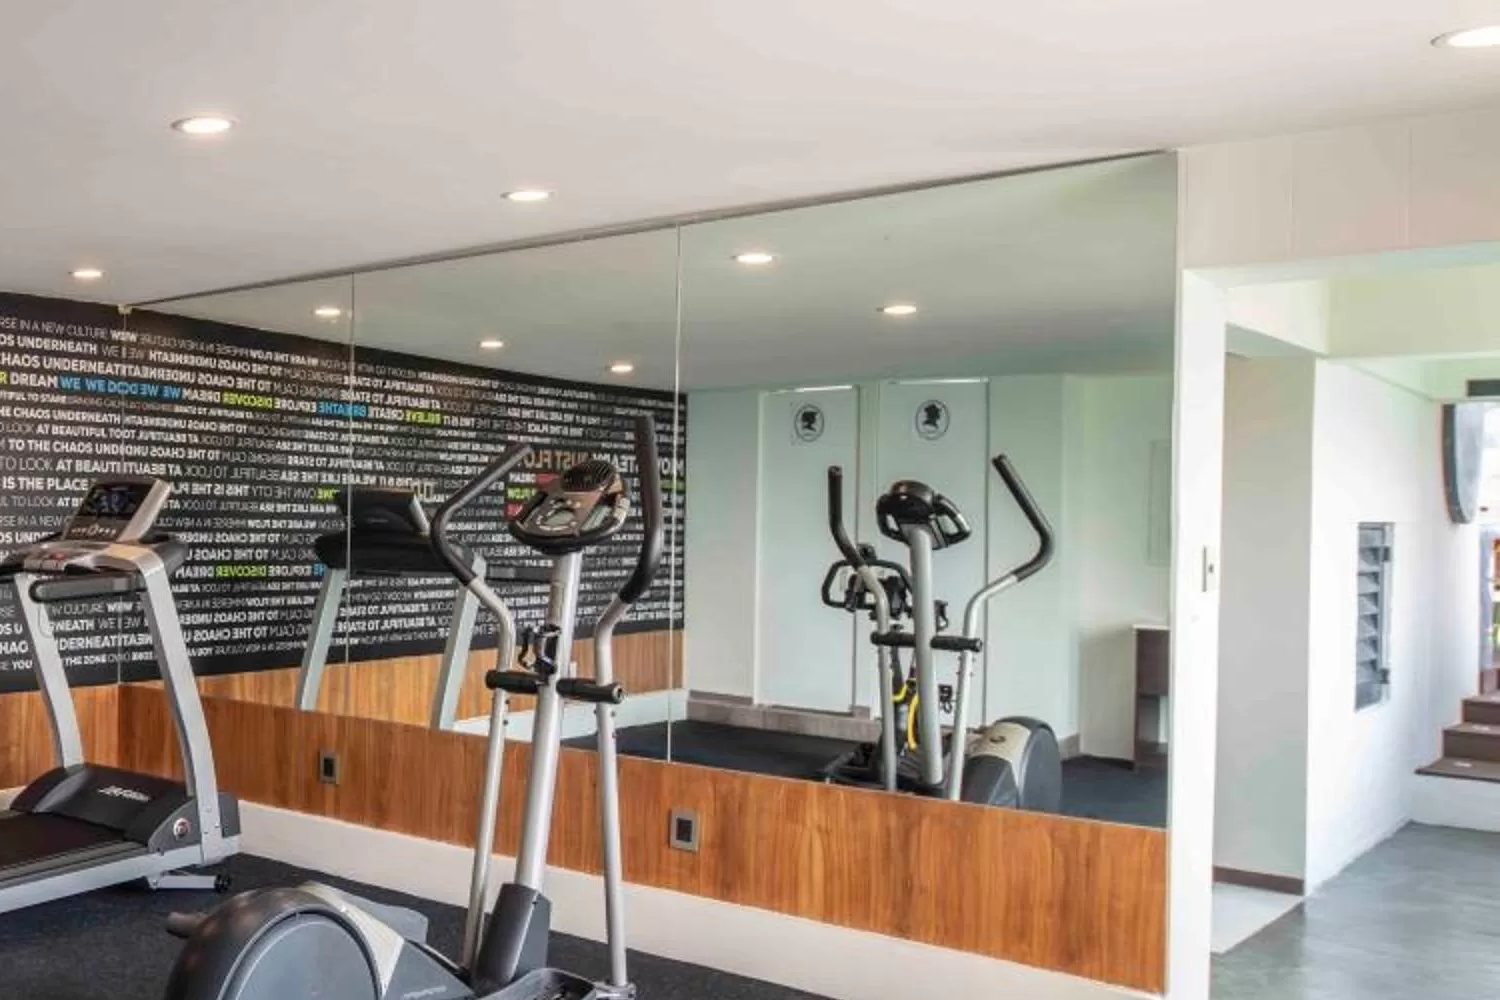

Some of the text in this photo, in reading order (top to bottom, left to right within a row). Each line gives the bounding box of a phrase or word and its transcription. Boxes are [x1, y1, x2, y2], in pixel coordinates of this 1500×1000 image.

[10, 372, 58, 388] DREAM
[60, 376, 80, 389] WE
[2, 476, 16, 489] IS
[18, 477, 44, 490] THE
[46, 478, 88, 491] PLACE
